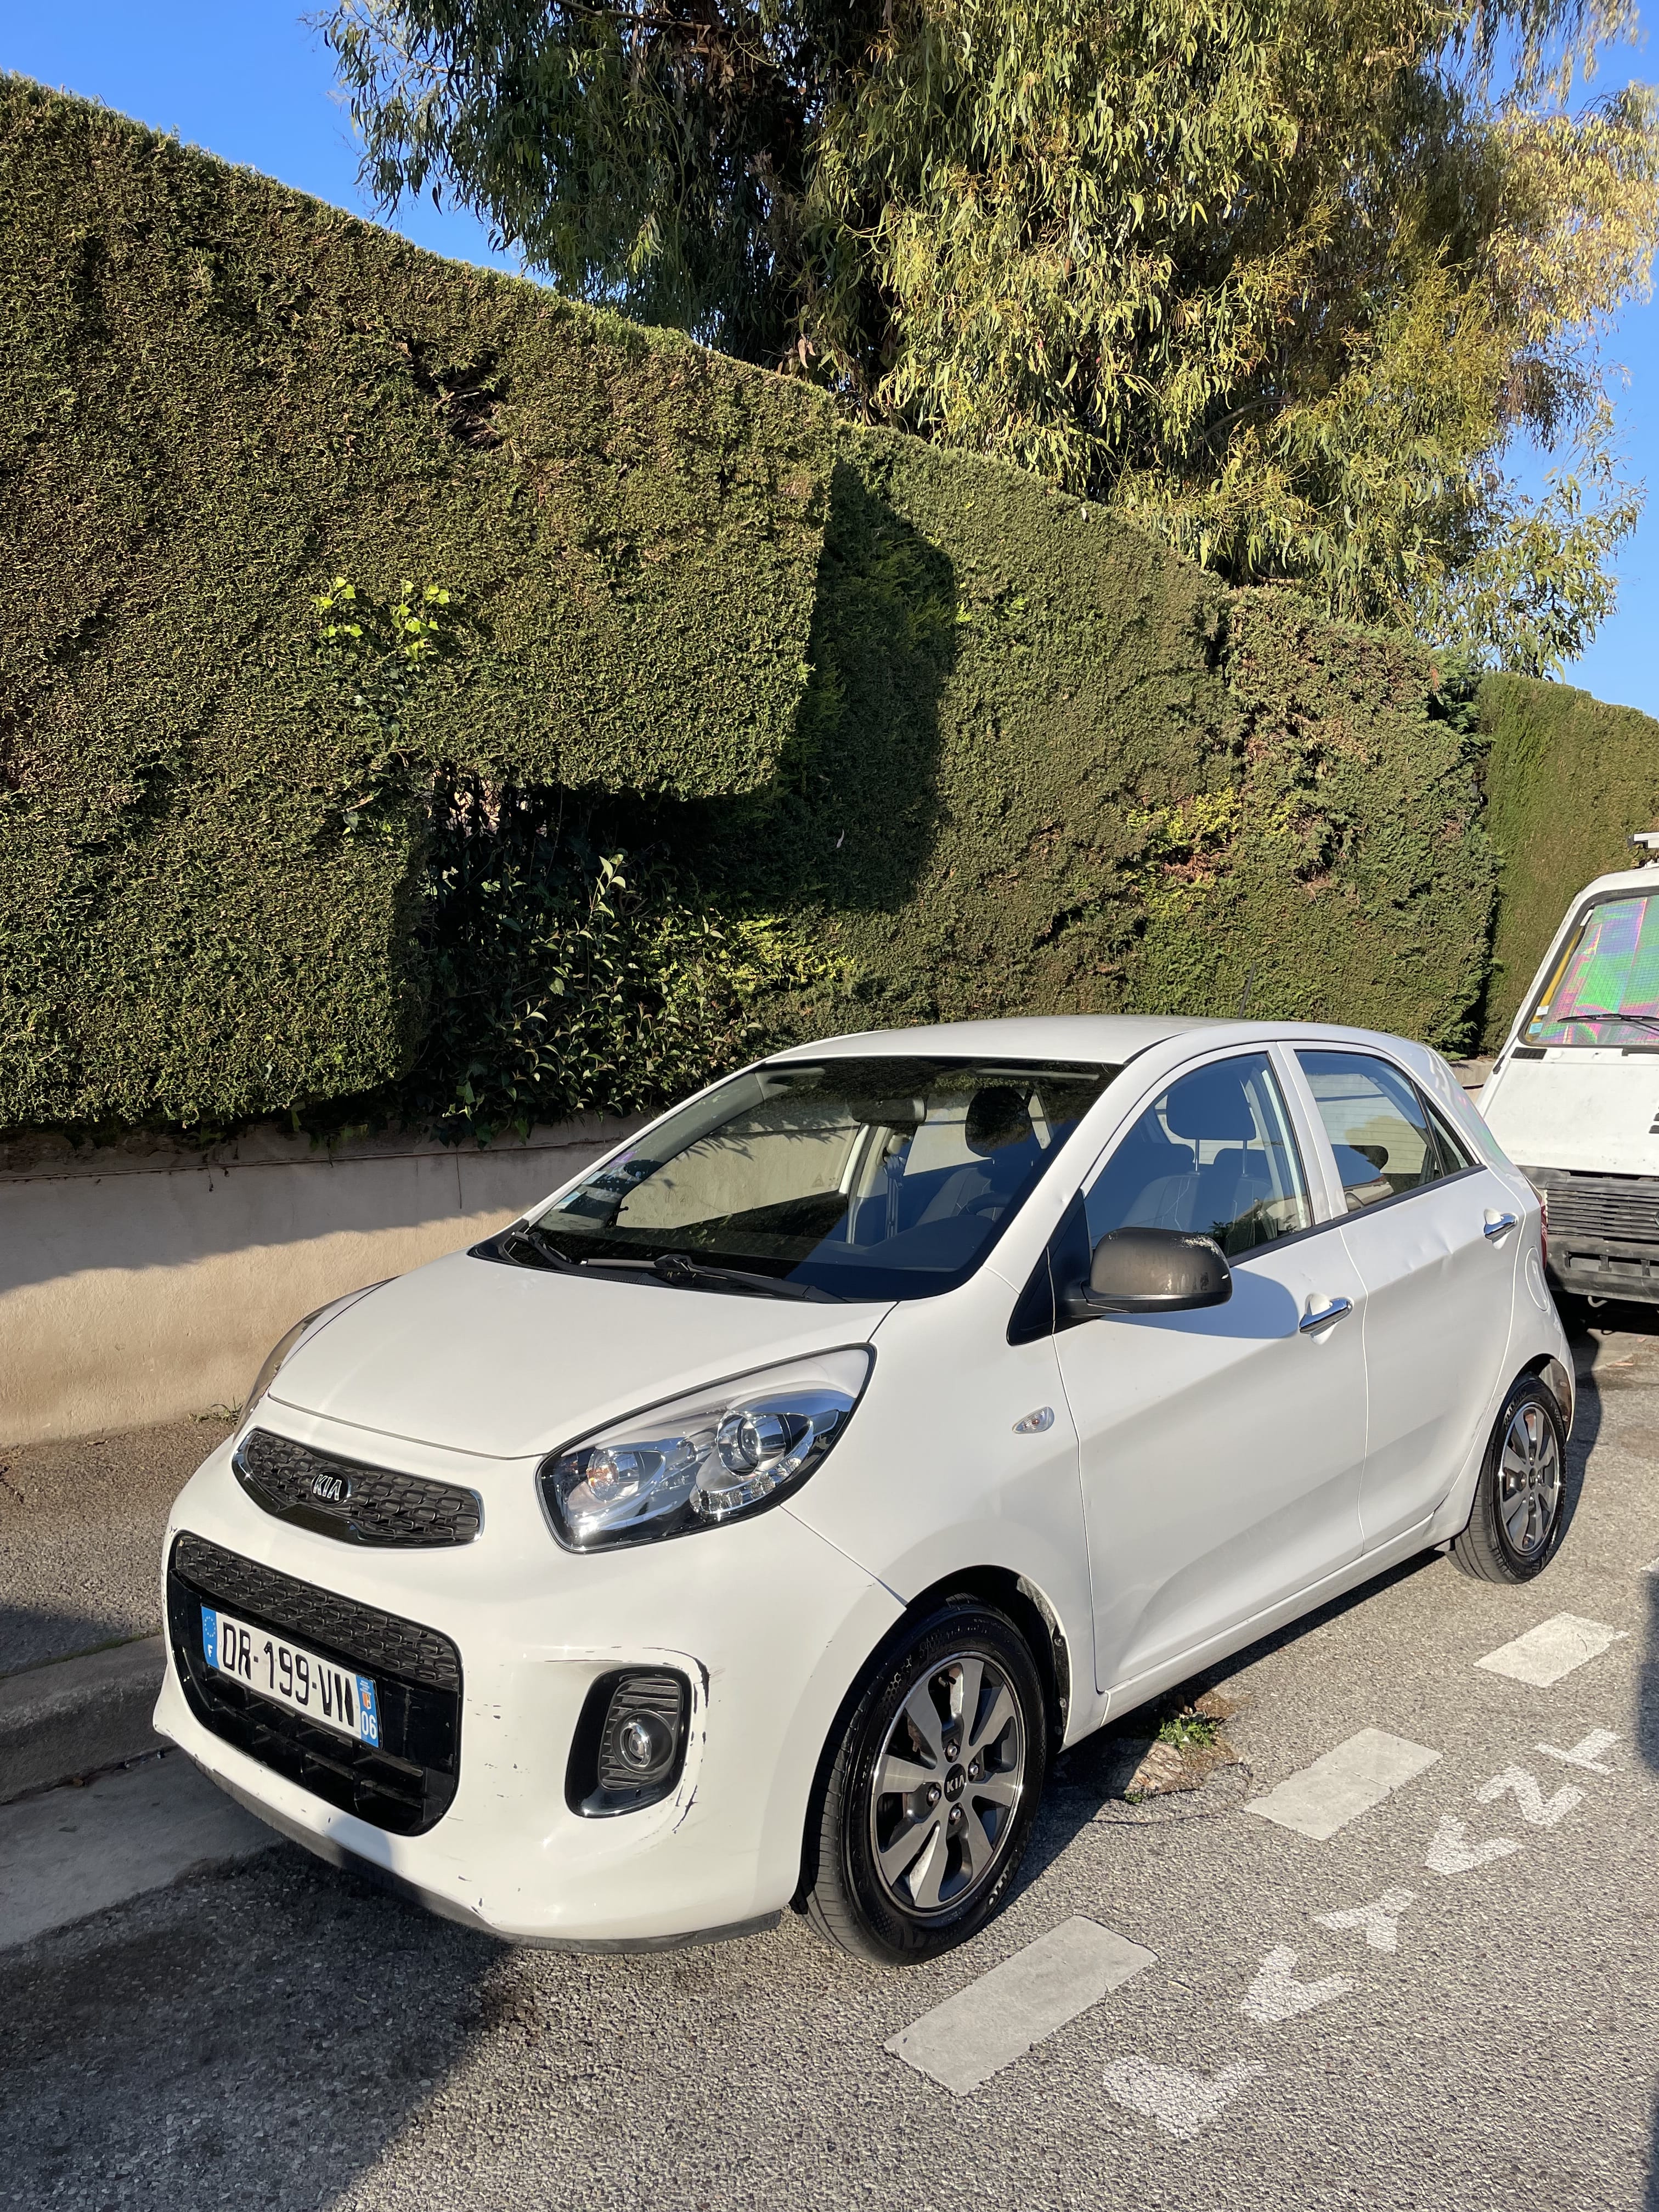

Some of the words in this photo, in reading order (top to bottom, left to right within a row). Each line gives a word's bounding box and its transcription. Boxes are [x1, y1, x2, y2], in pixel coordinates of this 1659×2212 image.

[313, 1474, 342, 1501] KIA
[207, 1644, 213, 1658] F
[223, 1622, 355, 1728] DR-199-VN
[361, 1711, 377, 1740] 06
[946, 1774, 964, 1793] KIA
